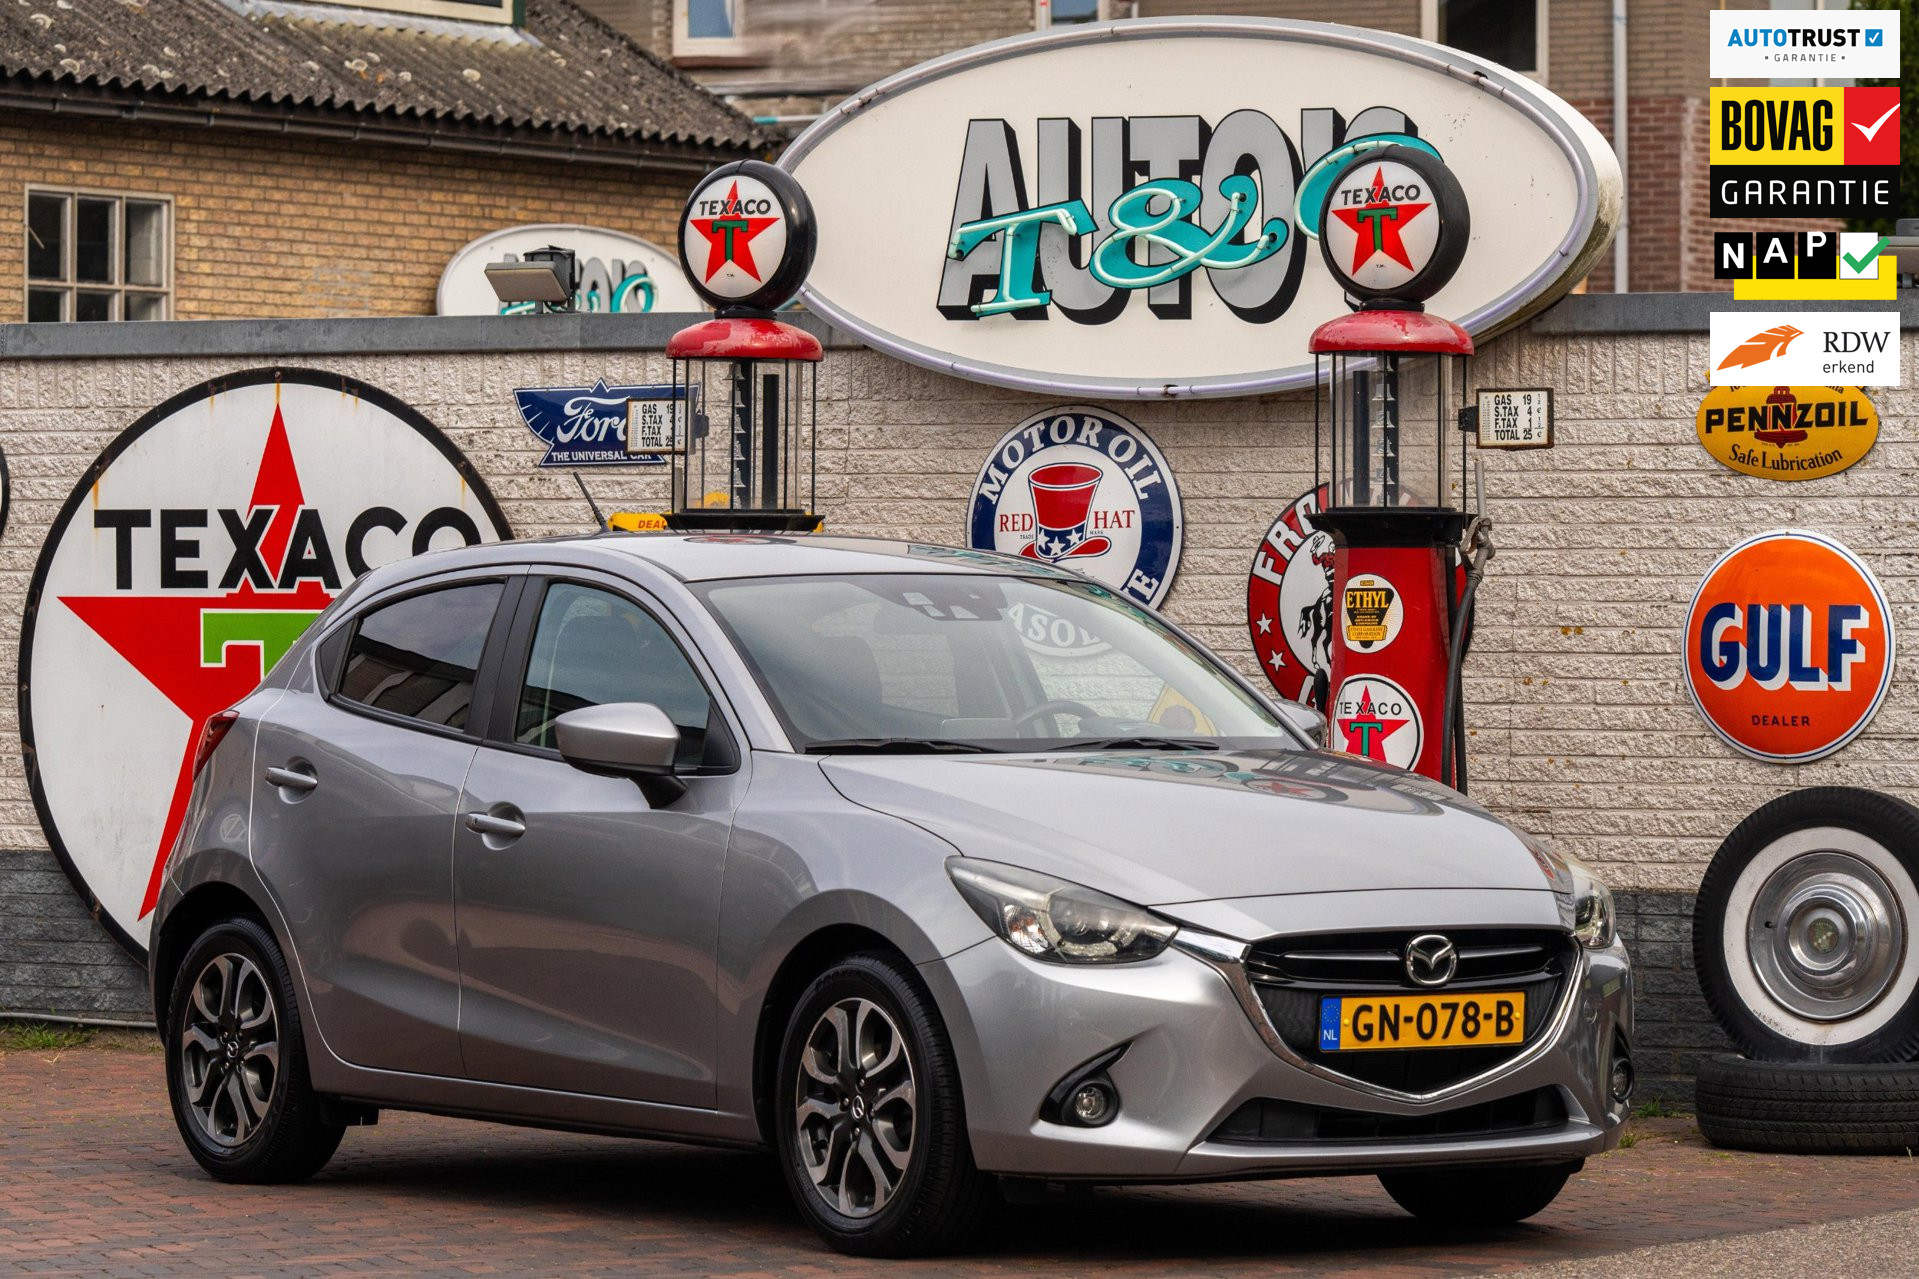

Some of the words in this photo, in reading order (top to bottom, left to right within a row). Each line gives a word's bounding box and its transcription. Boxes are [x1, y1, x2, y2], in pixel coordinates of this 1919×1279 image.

[1341, 184, 1421, 206] TEXACO
[699, 199, 771, 216] TEXACO
[1494, 394, 1512, 406] GAS
[1522, 394, 1532, 405] 19
[642, 404, 657, 414] GAS
[1494, 406, 1519, 417] S.TAX
[1526, 406, 1532, 416] 4
[642, 414, 663, 425] S.TAX
[1705, 401, 1868, 433] PENNZOIL
[1494, 418, 1518, 429] F.TAX
[642, 426, 661, 436] F.TAX
[1494, 430, 1520, 440] TOTAL
[1523, 429, 1533, 440] 25
[642, 437, 663, 447] TOTAL
[551, 452, 570, 461] THE
[571, 450, 627, 461] UNIVERSAL
[978, 415, 1103, 505] MOTOR
[1107, 434, 1163, 500] OIL
[1729, 443, 1759, 466] Safe
[1761, 449, 1843, 471] Lubrication
[999, 513, 1034, 532] RED
[1093, 510, 1136, 529] HAT
[1346, 591, 1389, 609] ETHYL
[1700, 602, 1870, 692] GULF
[1339, 702, 1402, 715] TEXACO
[1751, 715, 1811, 727] DEALER
[1352, 1000, 1515, 1042] GN-078-B
[1323, 1029, 1338, 1041] NL
